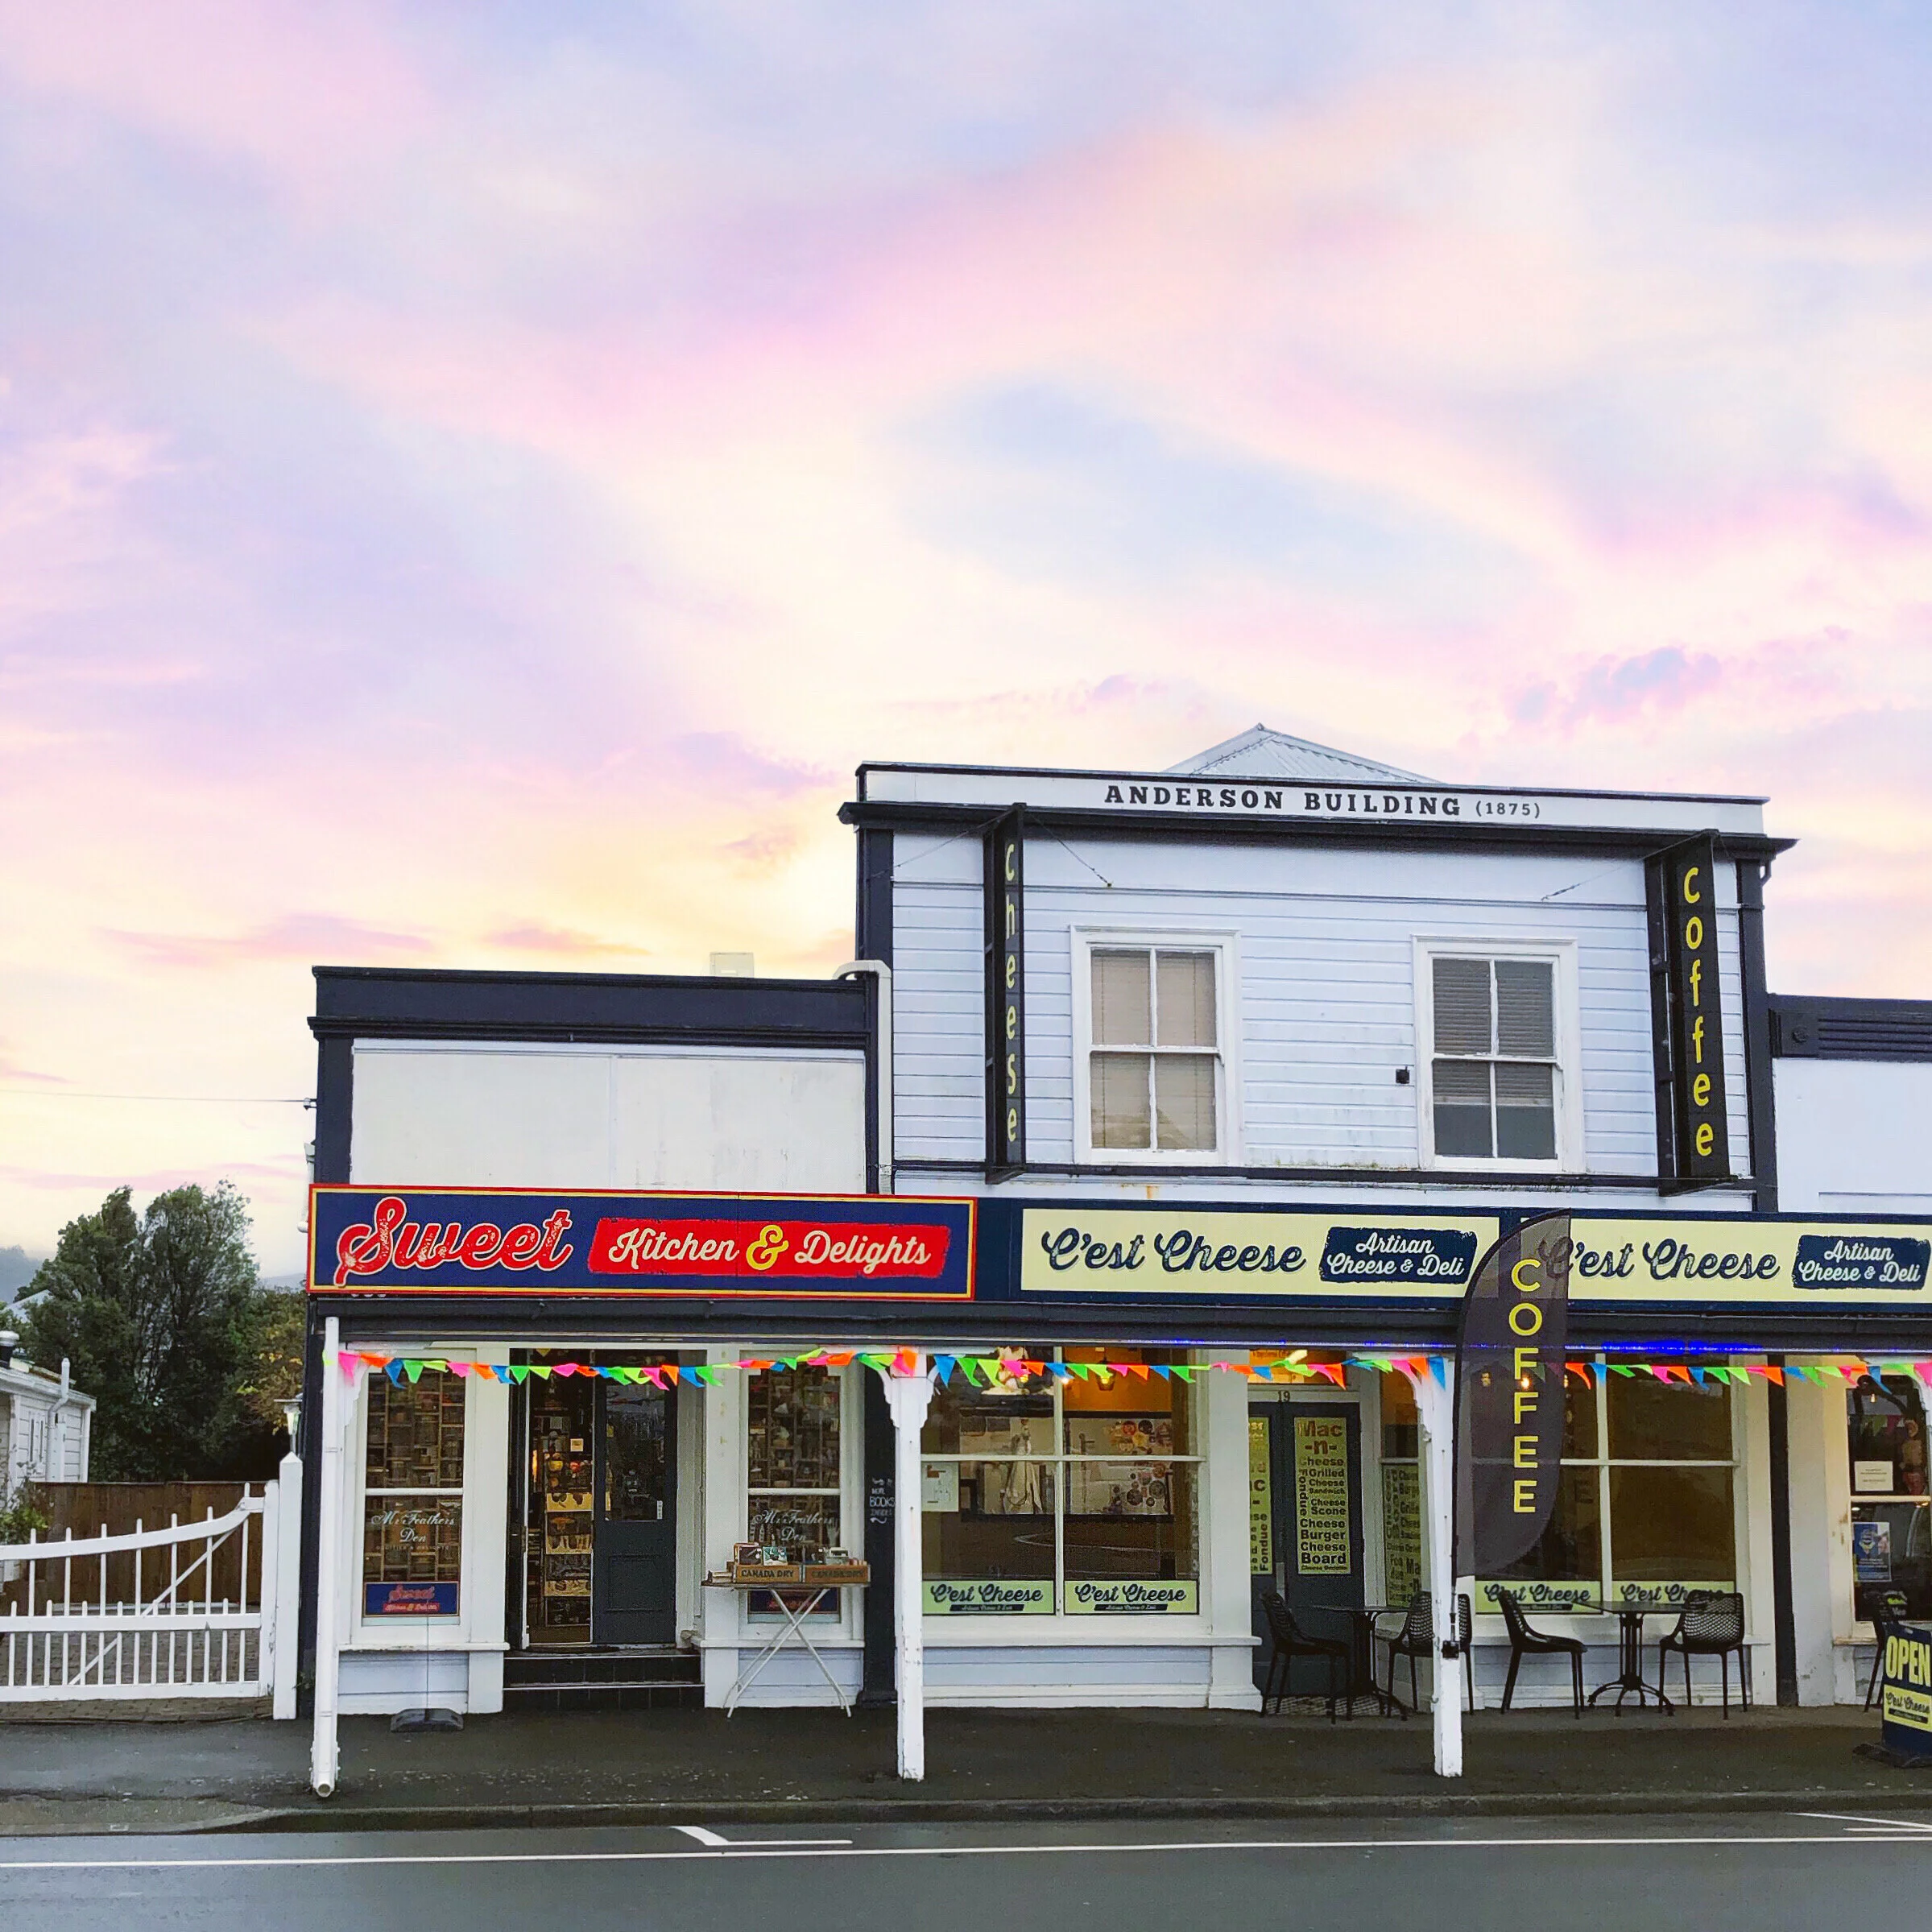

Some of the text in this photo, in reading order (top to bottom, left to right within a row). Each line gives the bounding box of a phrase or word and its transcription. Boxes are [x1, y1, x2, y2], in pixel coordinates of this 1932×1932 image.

[1105, 784, 1541, 819] ANDERSON BUILDING (1875)
[333, 1196, 573, 1289] Sweet
[608, 1224, 931, 1274] Kitchen & Delights
[1041, 1228, 1307, 1272] C'est Cheese
[1355, 1232, 1434, 1255] Artisan
[1824, 1239, 1894, 1262] Artisan
[1326, 1253, 1465, 1276] Cheese & Deli
[1643, 1238, 1781, 1280] Cheese
[1798, 1261, 1922, 1283] Cheese & Deli
[1508, 1258, 1543, 1513] COFFEE
[1277, 1390, 1290, 1402] 19
[1309, 1468, 1344, 1478] Grilled
[1309, 1479, 1344, 1487] Cheese
[870, 1496, 895, 1508] BOOKS
[1311, 1498, 1346, 1507] Cheese
[1311, 1506, 1347, 1515] Scone
[1300, 1518, 1346, 1528] Cheese
[399, 1527, 426, 1542] Den
[1301, 1529, 1346, 1541] Burger
[1259, 1523, 1269, 1571] Fondue
[1300, 1541, 1346, 1551] Cheese
[1301, 1552, 1347, 1564] Board
[741, 1570, 794, 1578] CANADA DRY
[930, 1583, 1044, 1603] C'est Cheese
[1074, 1583, 1187, 1603] C'est Cheese
[1529, 1583, 1591, 1603] Cheese
[1620, 1583, 1662, 1602] C'est
[1885, 1635, 1931, 1687] OPEN
